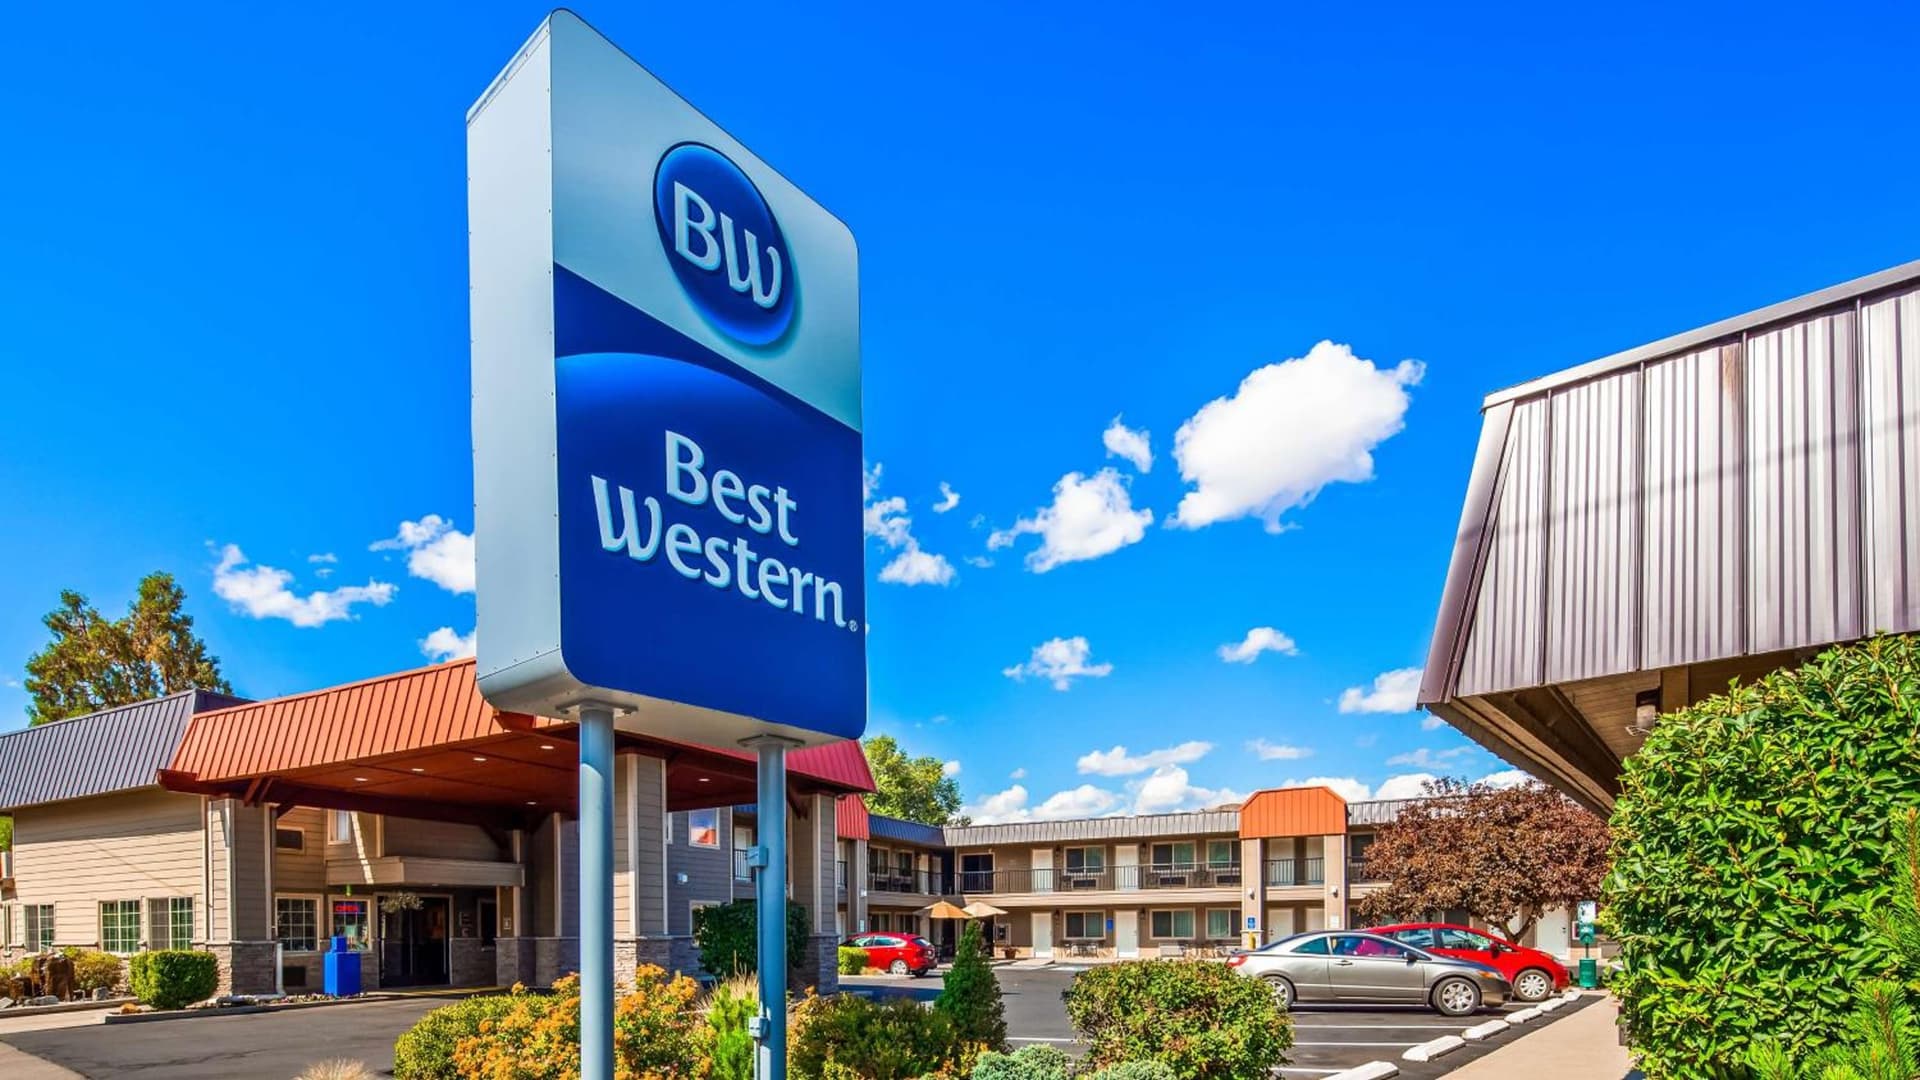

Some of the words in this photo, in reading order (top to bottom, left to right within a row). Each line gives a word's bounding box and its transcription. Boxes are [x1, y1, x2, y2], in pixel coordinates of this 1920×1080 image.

[674, 180, 782, 309] BW
[591, 474, 847, 628] Western
[665, 430, 799, 546] Best
